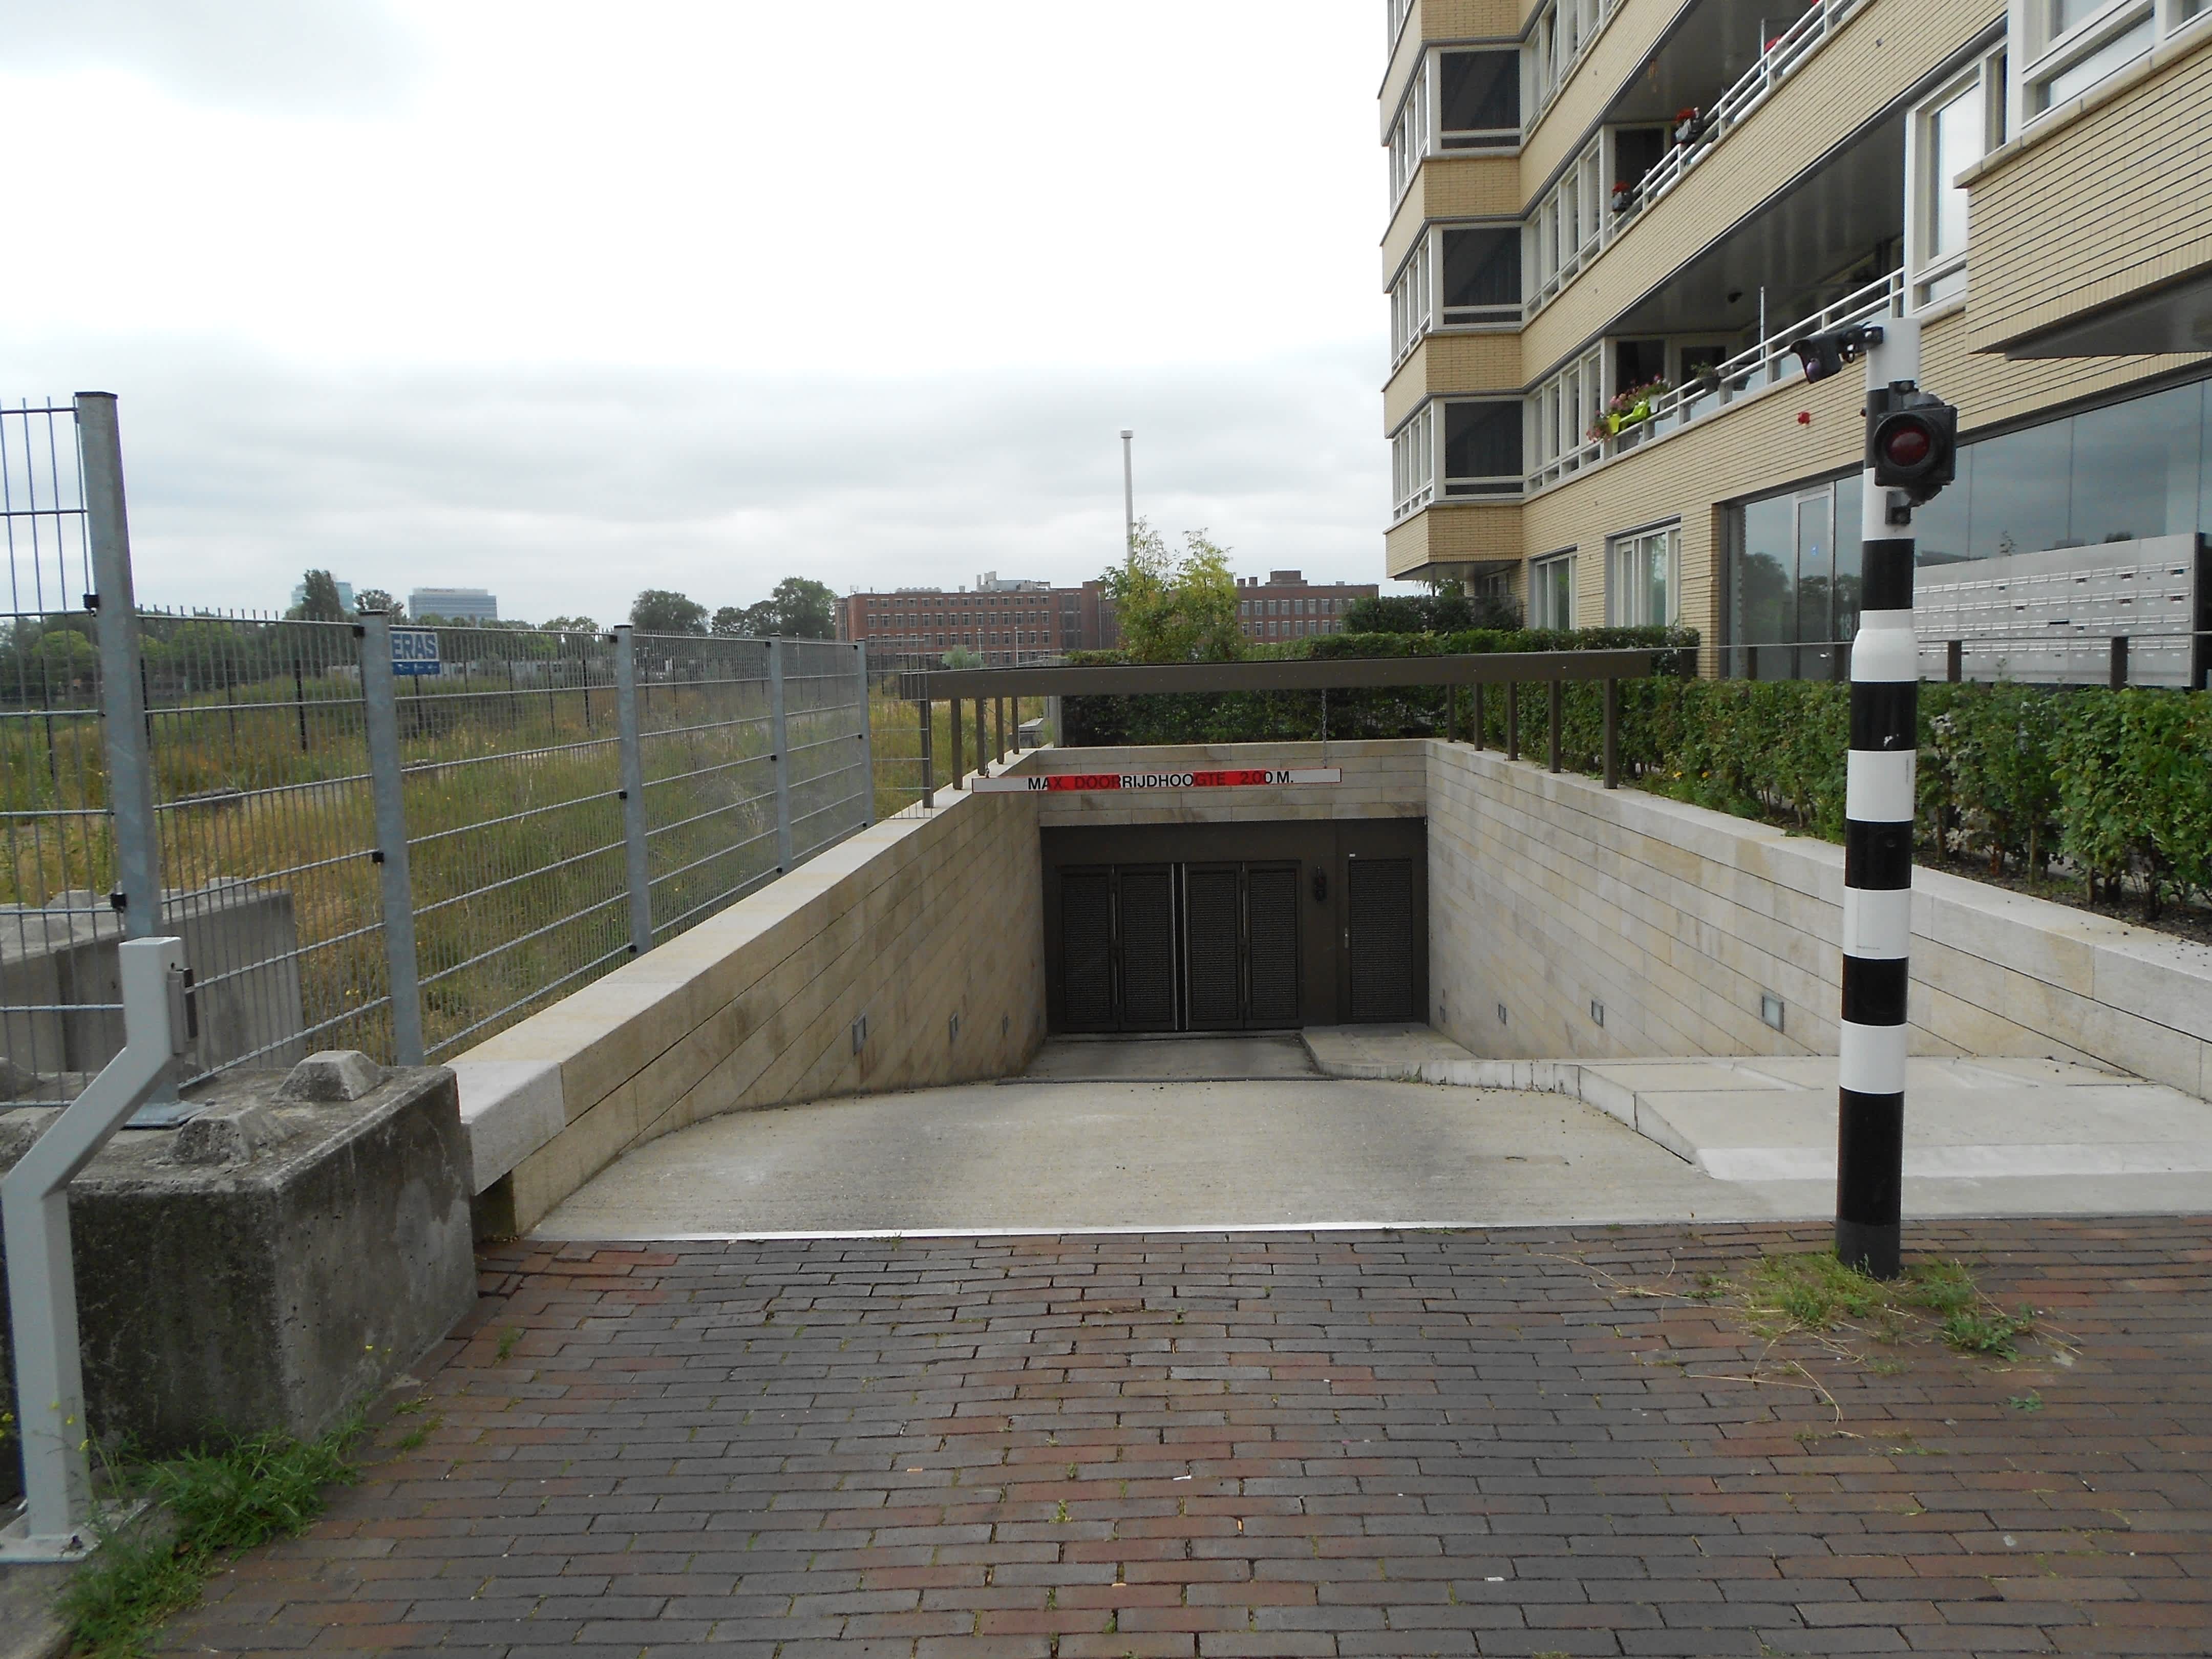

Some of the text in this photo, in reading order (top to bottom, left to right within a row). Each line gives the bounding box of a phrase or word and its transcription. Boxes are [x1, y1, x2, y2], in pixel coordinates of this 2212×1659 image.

[392, 633, 437, 660] ERAS
[1075, 773, 1225, 789] DOORRIJDHOOGTE
[1277, 771, 1294, 783] M.
